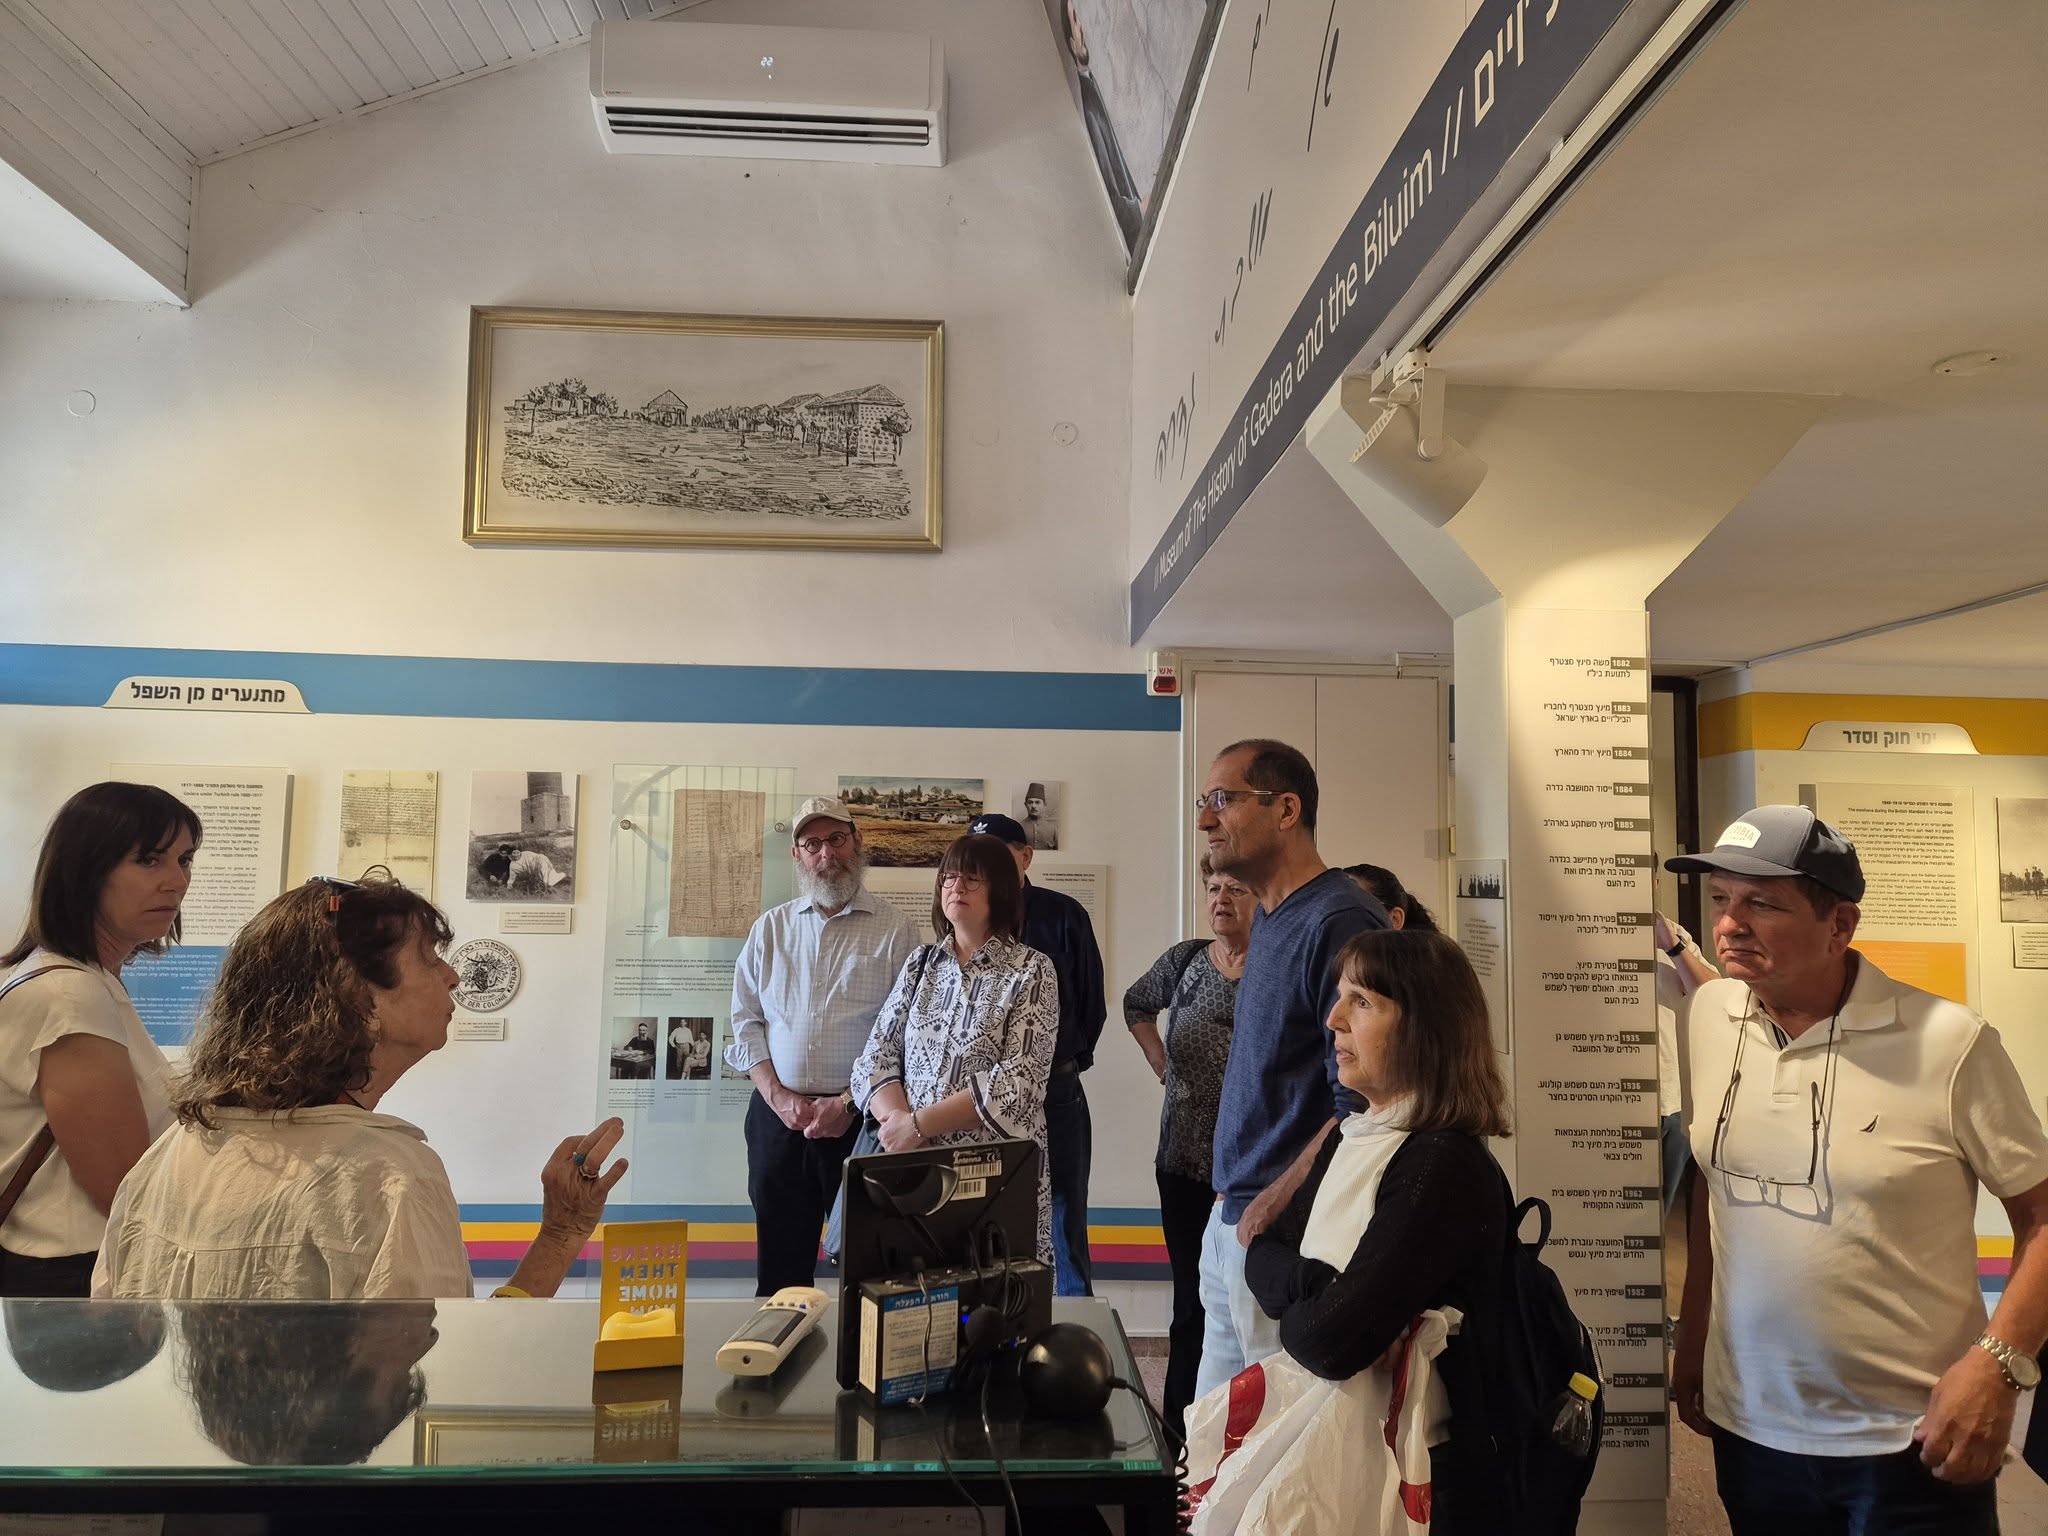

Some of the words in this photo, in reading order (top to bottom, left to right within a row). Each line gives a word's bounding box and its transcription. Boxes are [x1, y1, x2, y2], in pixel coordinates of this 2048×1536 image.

[1160, 531, 1184, 583] Museum
[1185, 507, 1192, 547] of
[1193, 495, 1206, 534] The
[1207, 446, 1236, 514] History
[1238, 419, 1249, 467] of
[1250, 361, 1293, 447] Gedera
[1297, 298, 1324, 382] and
[1328, 262, 1358, 334] the
[1364, 148, 1433, 286] Biluim
[1594, 659, 1610, 667] משה
[1612, 659, 1630, 667] 1882
[1159, 667, 1173, 675] אש
[131, 682, 181, 699] השפל
[187, 686, 205, 704] מן
[211, 687, 285, 703] מתנערים
[1556, 713, 1578, 722] ישראל
[1843, 731, 1878, 744] וסדר
[1884, 731, 1910, 748] חוק
[1917, 732, 1936, 744] ימי
[1614, 750, 1632, 758] 1884
[1546, 784, 1563, 792] גדרה
[1616, 821, 1634, 829] 1885
[1595, 868, 1605, 876] את
[1606, 880, 1622, 888] העם
[1623, 880, 1636, 888] בית
[468, 1000, 481, 1009] DER
[482, 994, 507, 1009] COLONIE
[1607, 1034, 1619, 1042] בית
[1603, 1045, 1615, 1053] של
[1608, 1082, 1620, 1090] בית
[1605, 1141, 1617, 1149] בית
[1552, 1189, 1564, 1197] בית
[1610, 1190, 1622, 1198] בית
[1545, 1237, 1569, 1246] למשכ
[1591, 1288, 1603, 1296] בית
